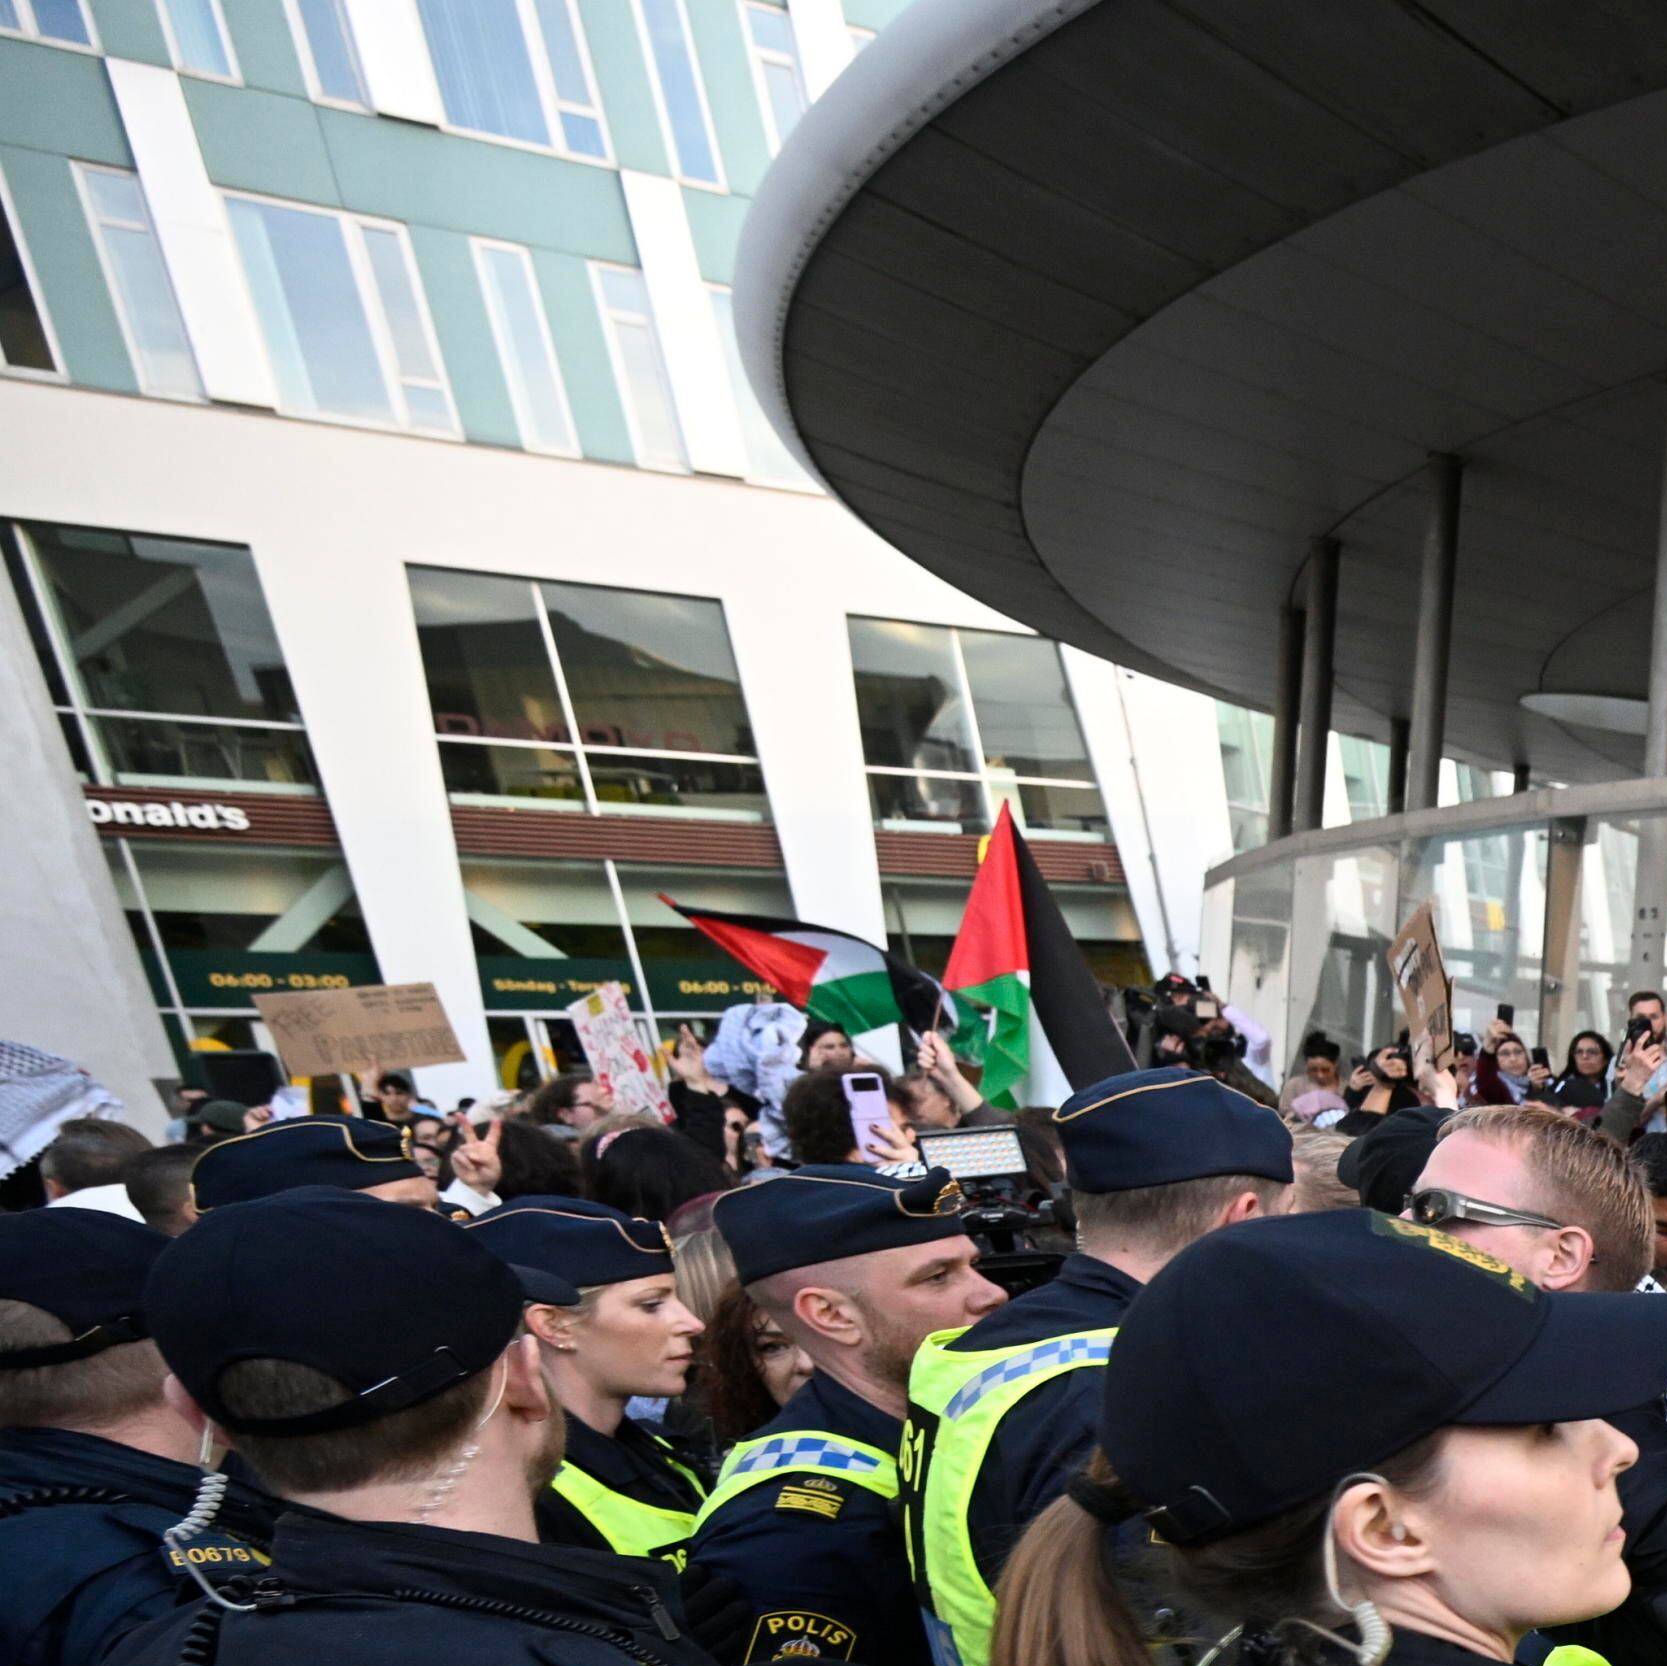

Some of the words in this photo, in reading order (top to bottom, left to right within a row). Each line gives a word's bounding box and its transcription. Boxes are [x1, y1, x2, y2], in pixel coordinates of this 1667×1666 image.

[209, 973, 273, 988] 06:00
[288, 973, 349, 988] 03:00
[678, 980, 729, 994] 06:00
[766, 1615, 849, 1645] POLIS
